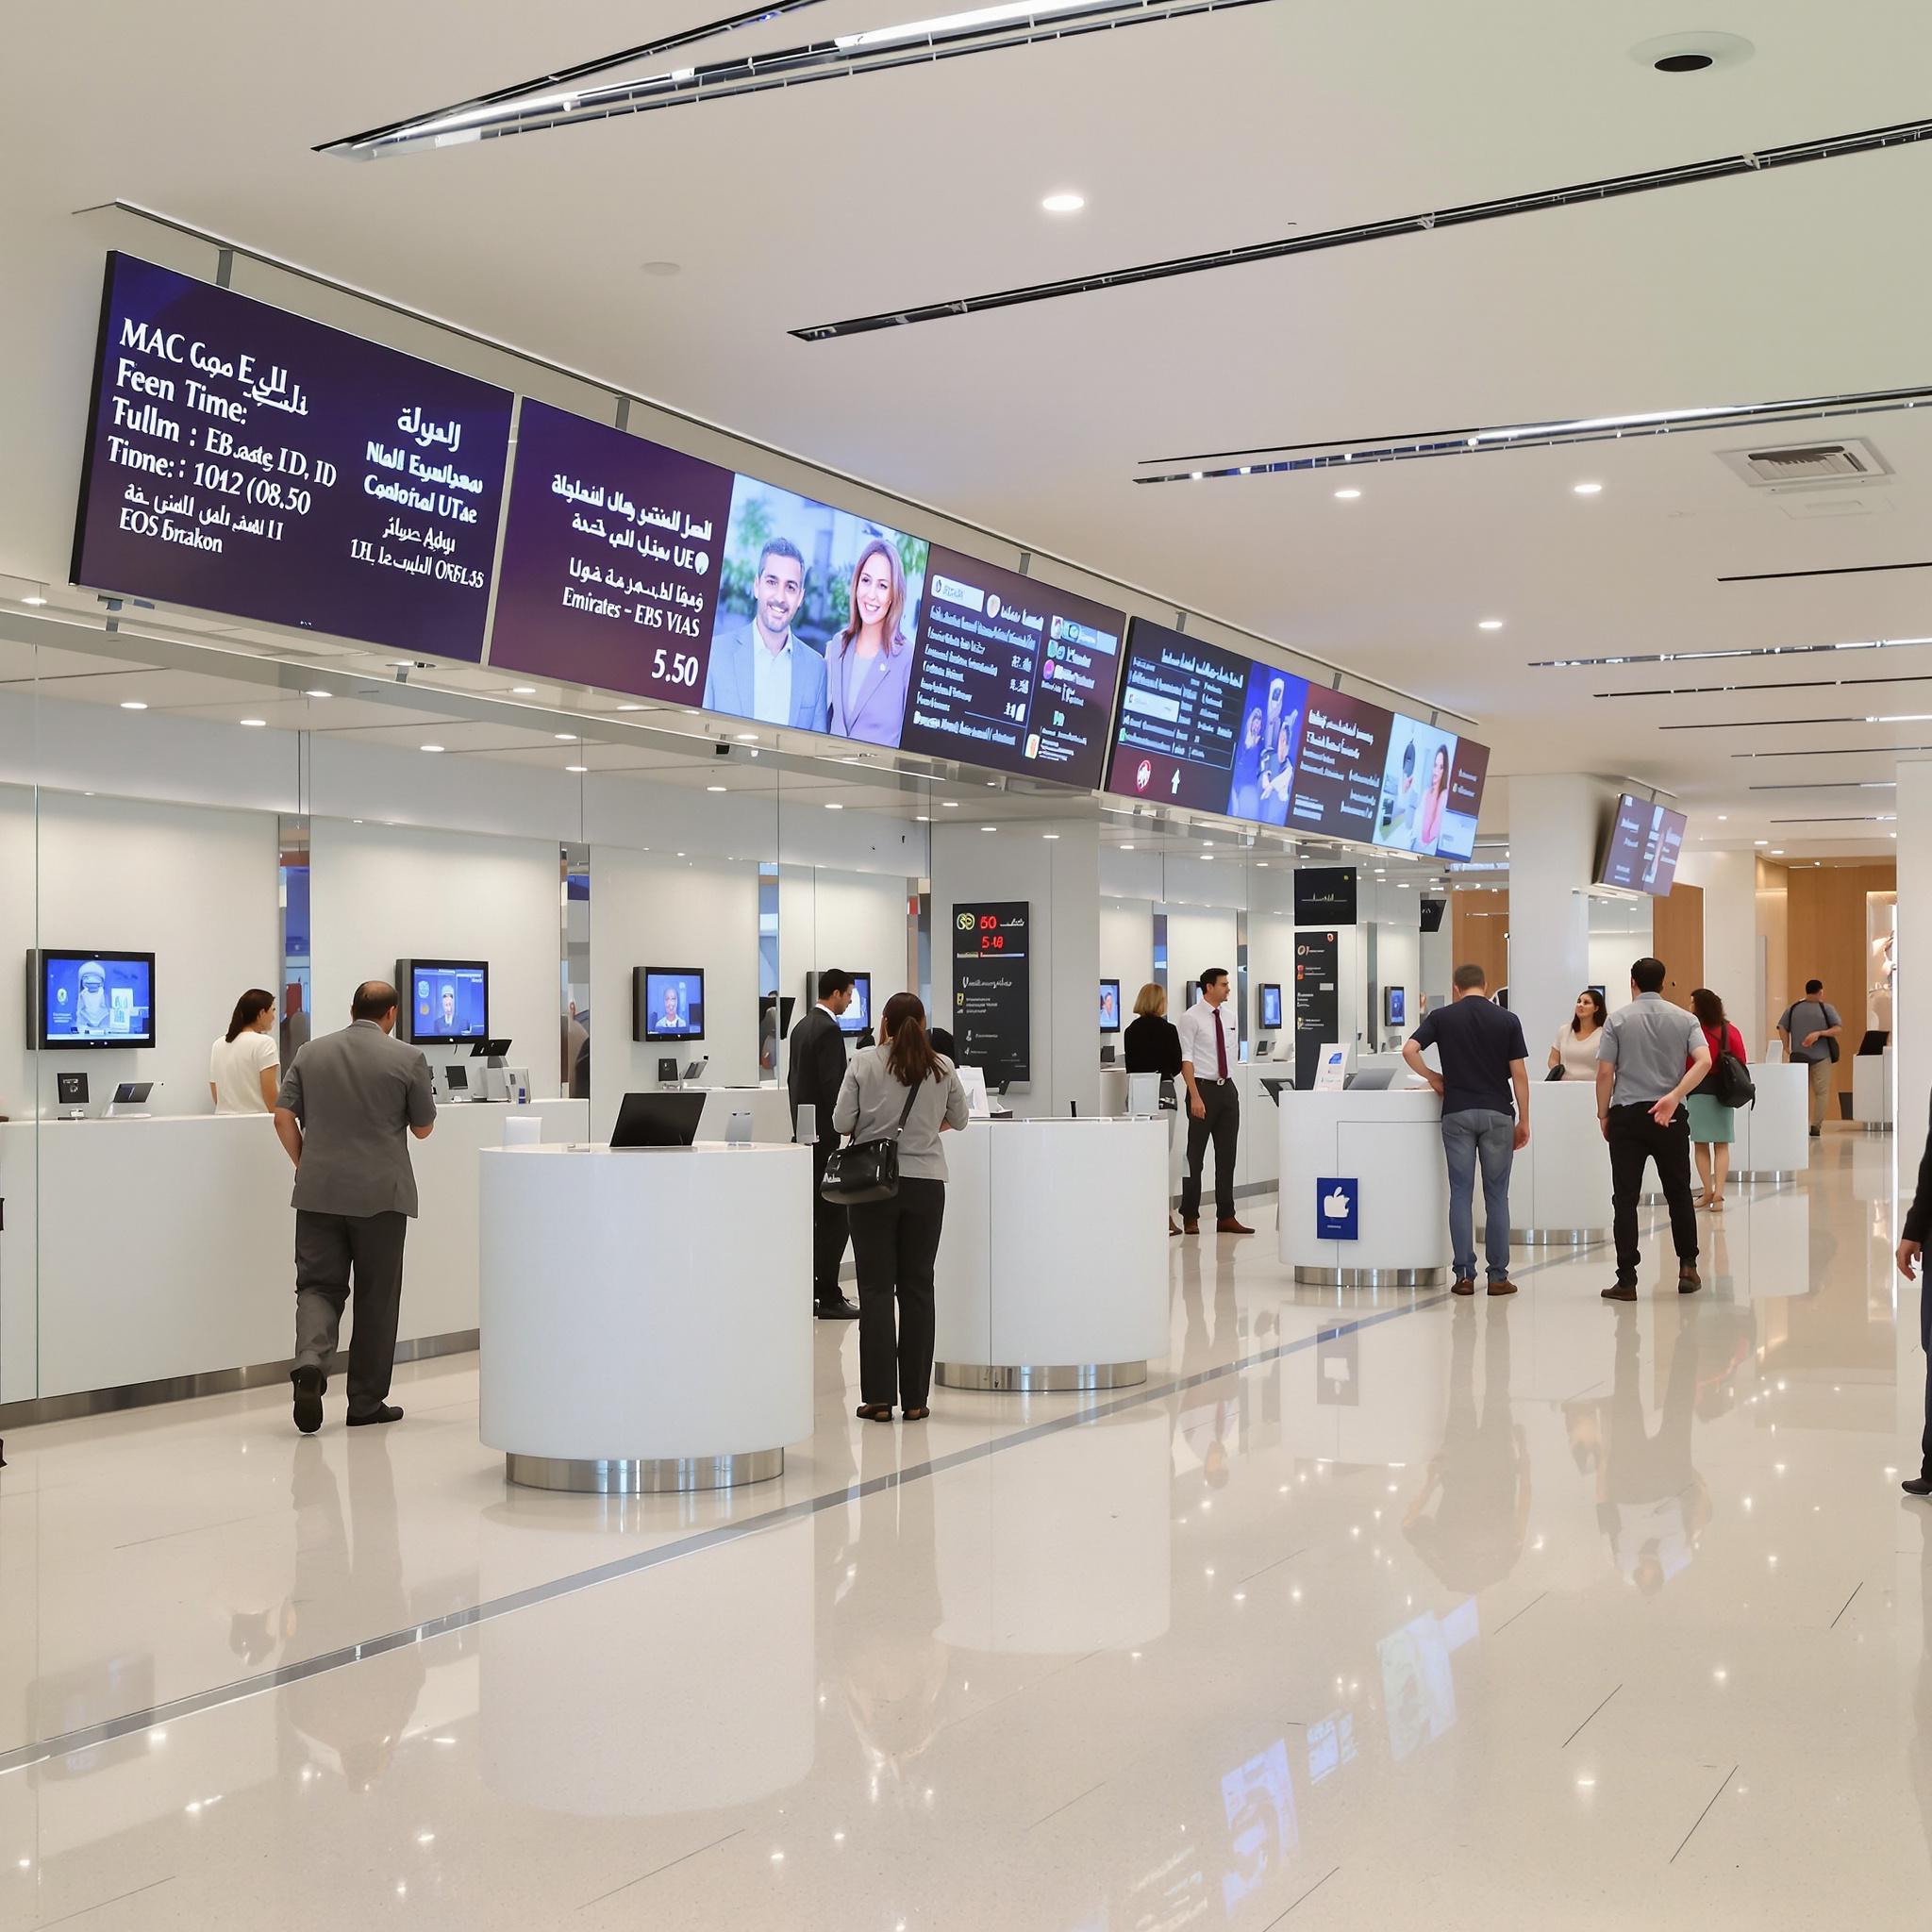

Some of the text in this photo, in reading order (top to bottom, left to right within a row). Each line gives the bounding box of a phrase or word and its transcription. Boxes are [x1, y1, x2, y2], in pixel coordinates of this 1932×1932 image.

[119, 317, 186, 363] MAC
[116, 358, 248, 425] Feen Time:
[314, 460, 337, 488] ID
[562, 587, 622, 619] Emirates
[651, 648, 699, 687] 5.50
